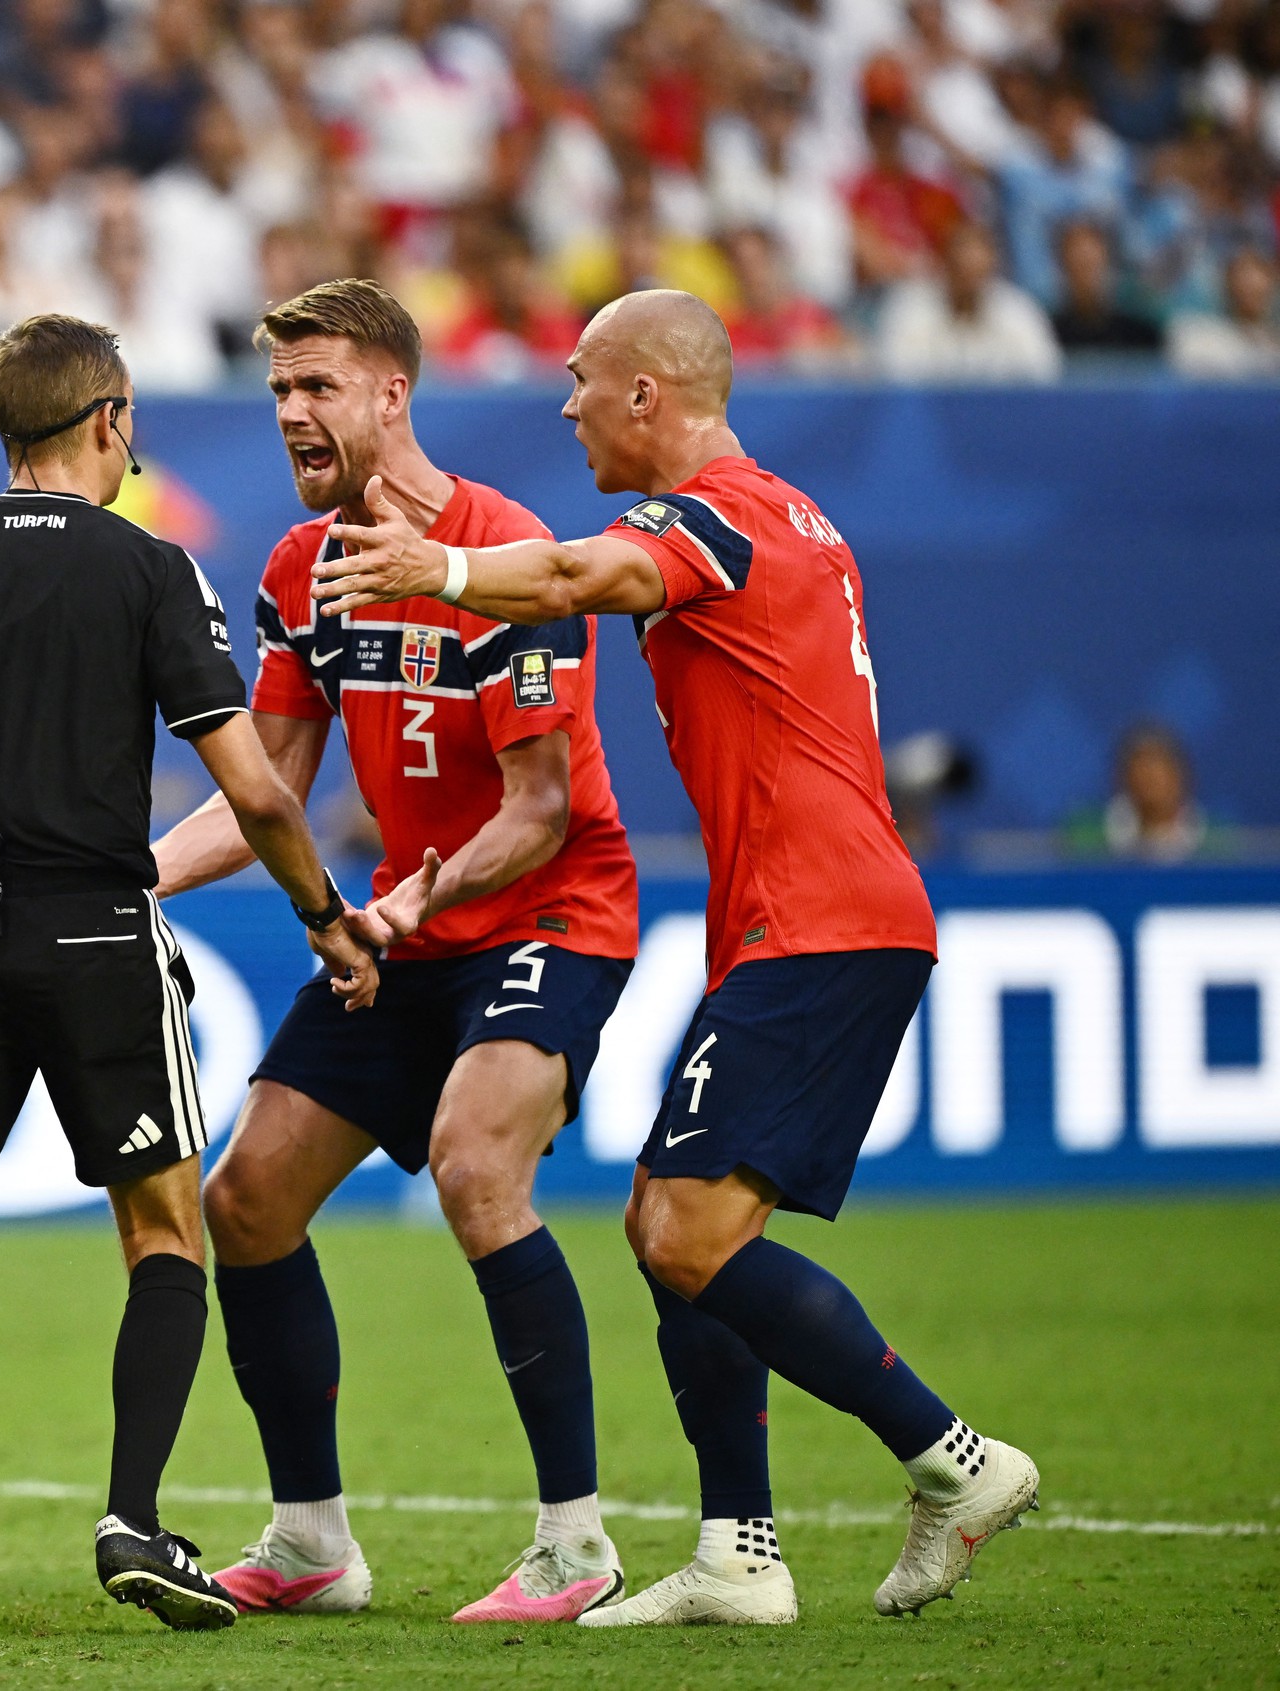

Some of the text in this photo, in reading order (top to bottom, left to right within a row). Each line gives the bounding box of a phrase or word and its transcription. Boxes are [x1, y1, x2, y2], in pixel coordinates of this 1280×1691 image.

[3, 514, 67, 529] TURPIN
[402, 698, 439, 777] 3
[683, 1032, 718, 1114] 4
